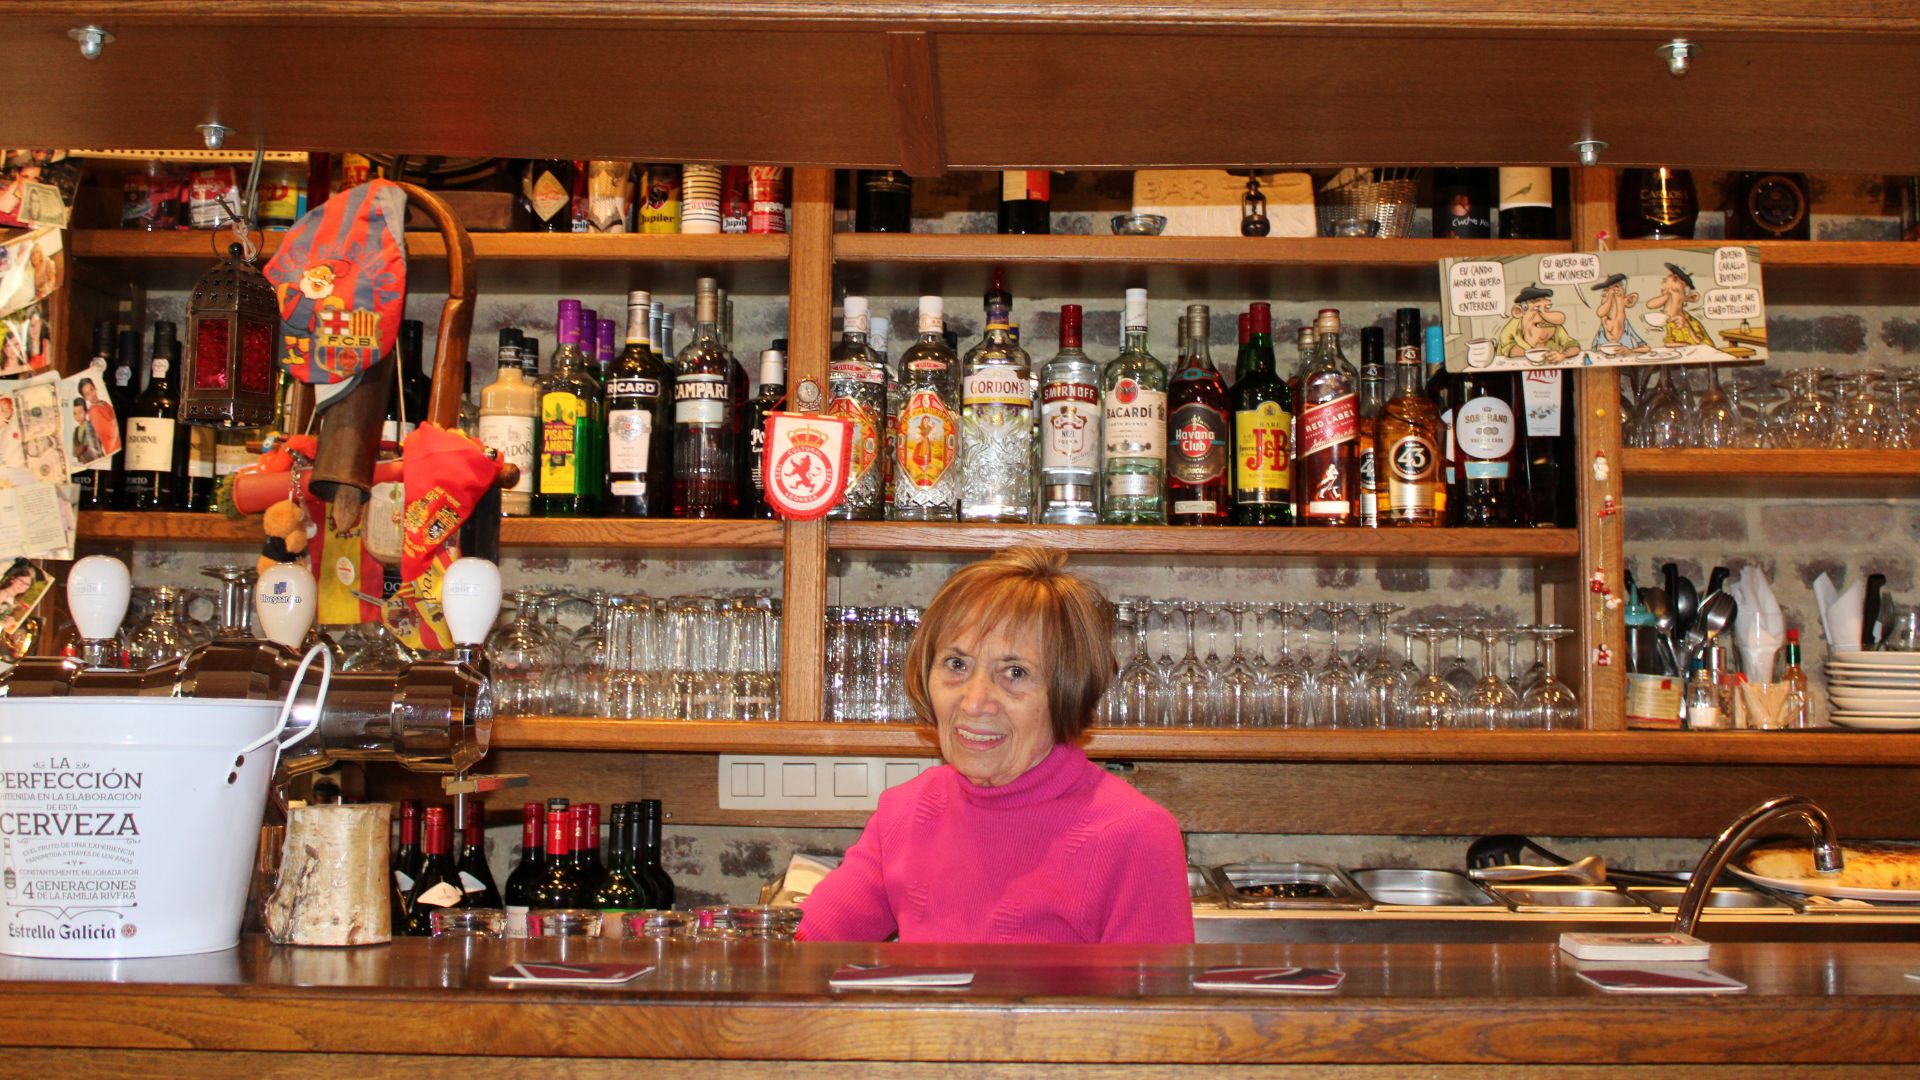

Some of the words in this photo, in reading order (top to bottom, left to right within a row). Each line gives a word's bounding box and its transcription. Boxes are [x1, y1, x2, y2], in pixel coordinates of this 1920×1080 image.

[641, 214, 675, 224] Jupiler
[1543, 260, 1552, 268] EU
[1555, 259, 1577, 267] QUERO
[1580, 258, 1594, 266] QUE
[1459, 266, 1469, 275] EU
[1471, 266, 1492, 275] CANDO
[1544, 272, 1555, 280] ME
[1558, 270, 1594, 280] INCINEREN
[1453, 279, 1476, 288] MORRA
[1479, 278, 1501, 286] QUERO
[1464, 291, 1478, 300] QUE
[1481, 290, 1491, 298] ME
[1459, 301, 1498, 312] ENTERREN!
[607, 382, 655, 394] RICARD
[675, 382, 728, 399] CAMPARI
[970, 380, 1024, 394] GORDON'S
[1107, 404, 1152, 419] BACARDÍ
[1305, 420, 1324, 432] RED
[1326, 410, 1354, 425] LABEL
[544, 429, 573, 440] PISANG
[1176, 429, 1215, 440] Havana
[544, 441, 573, 452] AMBON
[1182, 440, 1206, 451] Club
[1246, 428, 1288, 471] J&B
[788, 446, 822, 457] CULTURAL
[1398, 446, 1426, 467] 43
[785, 492, 818, 503] LEONESA
[50, 758, 70, 769] LA
[38, 792, 50, 801] EN
[52, 793, 64, 801] LA
[66, 791, 142, 801] ELABORACIÓN
[0, 813, 140, 836] CERVEZA
[38, 844, 59, 852] FRUTO
[88, 843, 135, 857] EXPERIENCIA
[22, 881, 34, 899] 4
[36, 880, 136, 891] GENERACIONES
[9, 922, 55, 939] Estrella
[59, 924, 116, 940] Galicia
